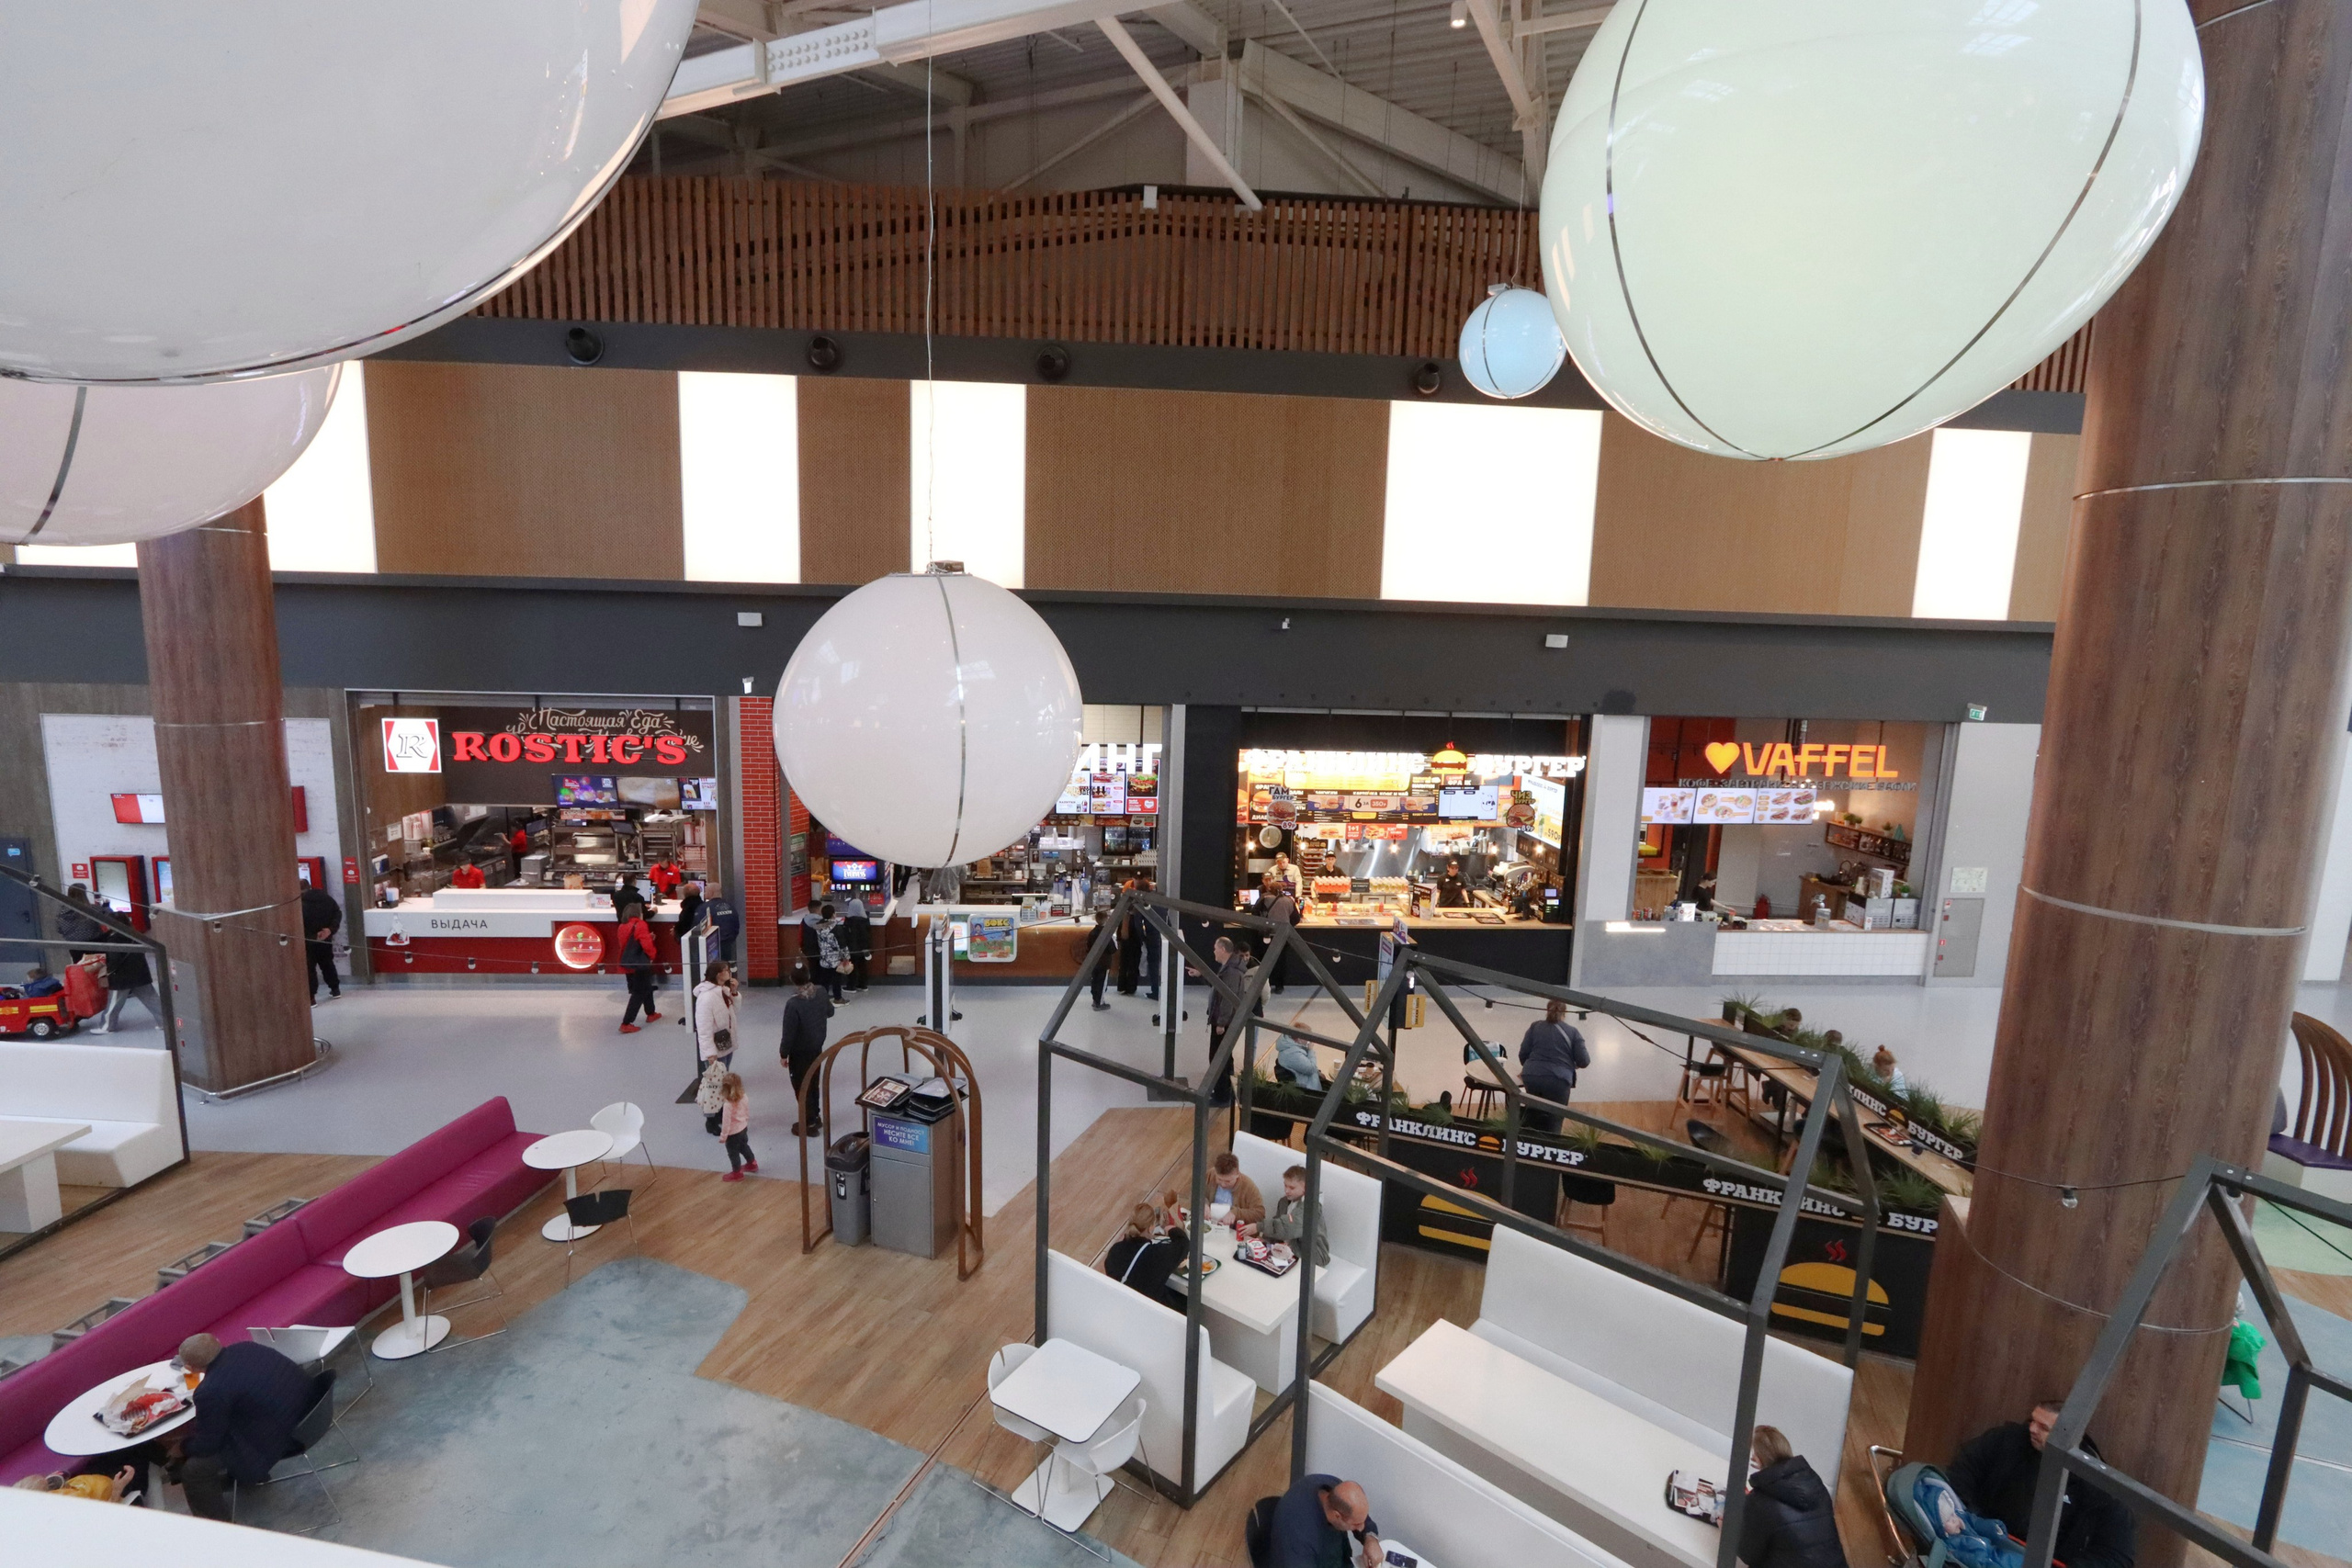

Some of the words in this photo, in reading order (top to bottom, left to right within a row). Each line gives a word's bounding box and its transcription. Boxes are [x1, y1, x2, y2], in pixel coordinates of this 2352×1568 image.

[630, 709, 663, 734] Еда
[451, 732, 687, 764] ROSTIC'S
[1474, 754, 1585, 777] БУРГЕР
[1742, 742, 1899, 777] VAFFEL
[1269, 786, 1290, 795] ГАМ
[1679, 778, 1714, 788] КОФЕ
[1355, 798, 1363, 808] 6
[1511, 791, 1532, 799] ЧИЗ
[431, 919, 488, 931] ВЫДАЧА
[884, 1129, 906, 1138] НЕСИТЕ
[908, 1133, 919, 1141] ВСЕ
[1907, 1120, 1964, 1161] БУРГЕР
[1502, 1137, 1586, 1166] УРГЕР
